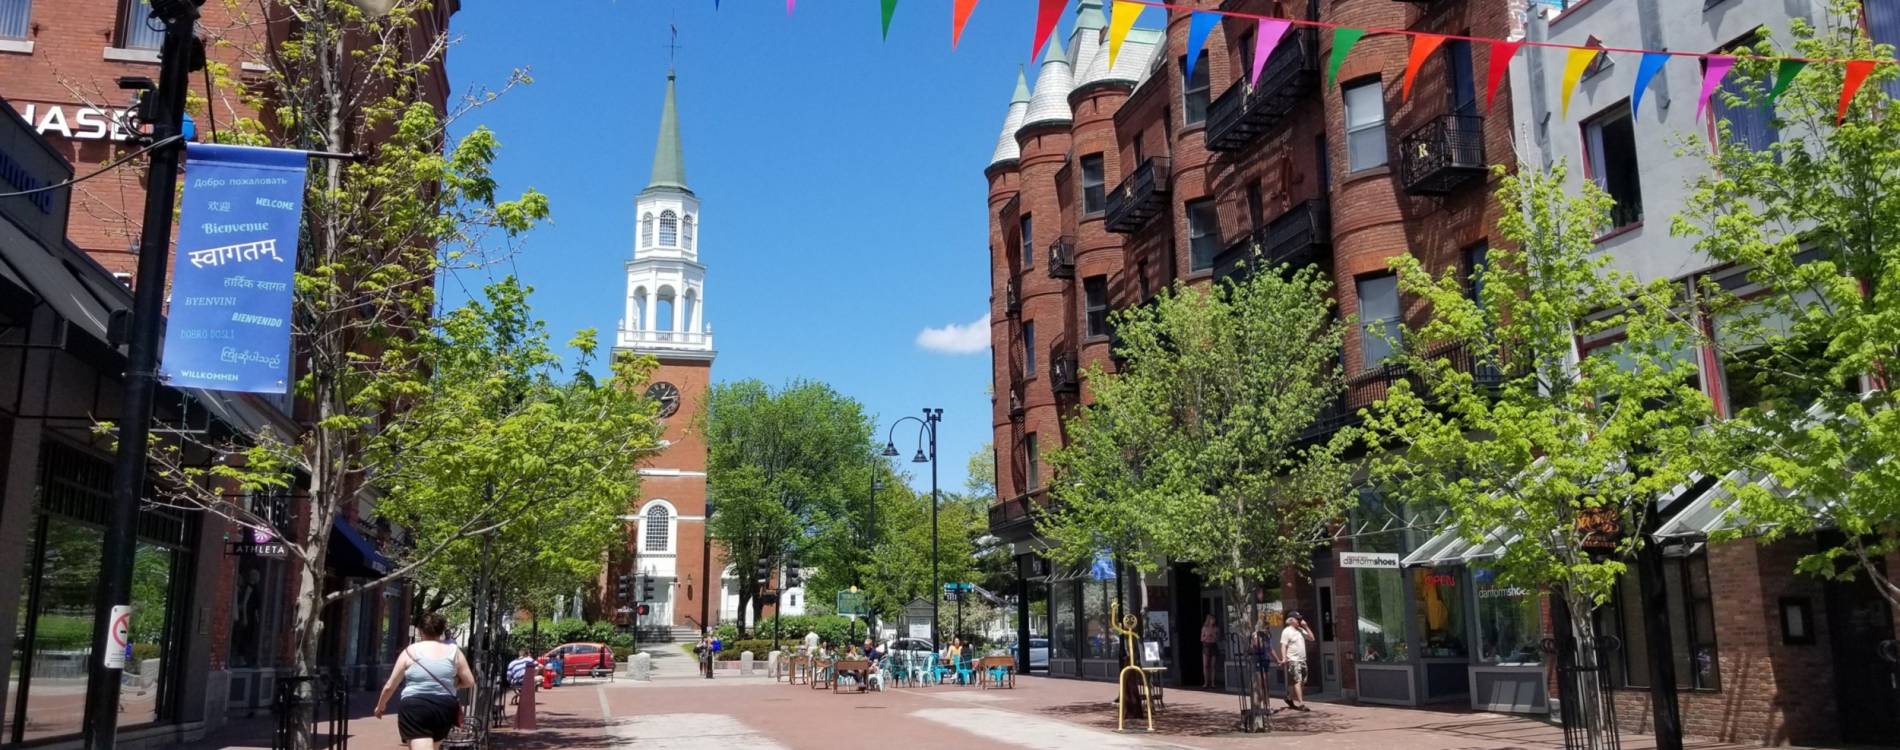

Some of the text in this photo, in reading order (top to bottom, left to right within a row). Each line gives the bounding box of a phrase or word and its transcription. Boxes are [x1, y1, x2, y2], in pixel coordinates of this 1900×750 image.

[194, 178, 288, 188] Добро пожаловать
[208, 200, 232, 212] 欢迎
[256, 197, 294, 210] WELCOME
[202, 222, 269, 234] Bienvenue
[188, 239, 283, 268] स्वागतम्
[224, 275, 287, 292] हार्दिक स्वागत
[185, 297, 237, 306] BYENVINI
[232, 312, 283, 327] BIENVENIDO
[180, 329, 207, 339] DOBRO
[181, 370, 239, 381] WILLKOMMEN
[236, 545, 285, 554] ATHLETA
